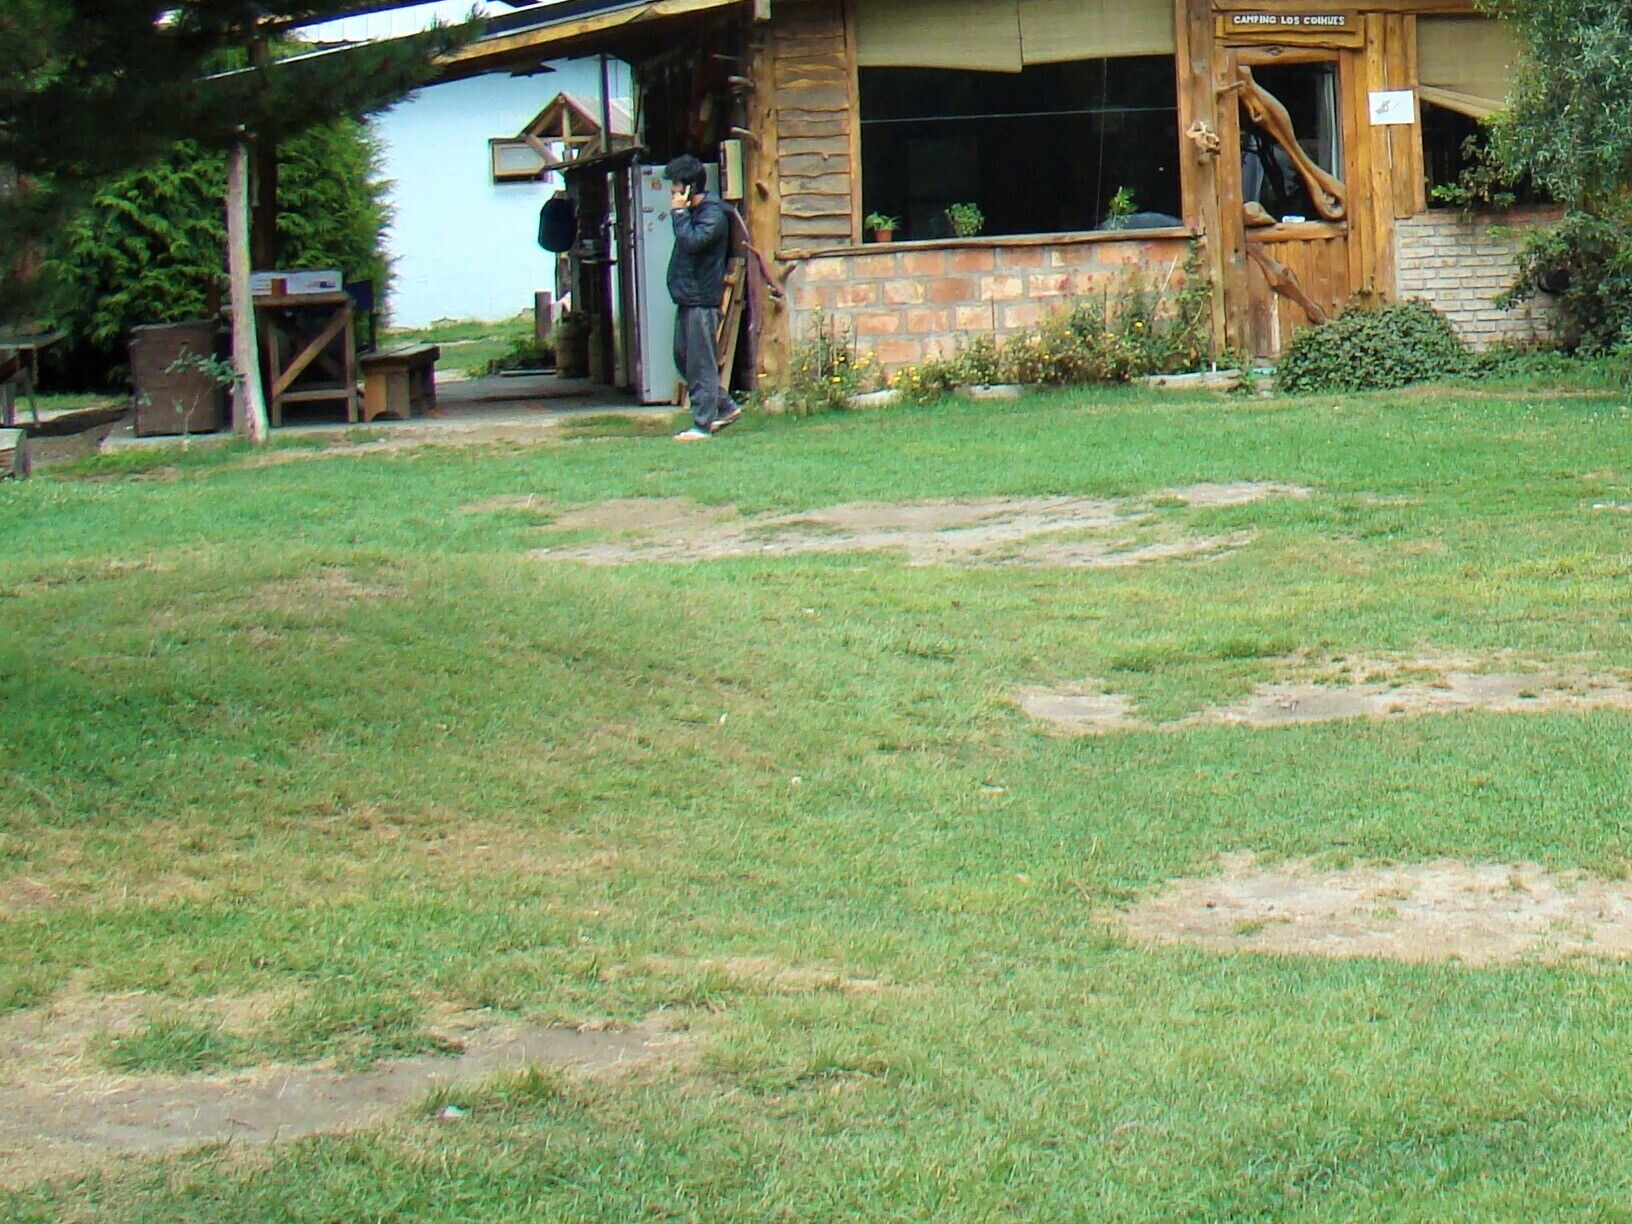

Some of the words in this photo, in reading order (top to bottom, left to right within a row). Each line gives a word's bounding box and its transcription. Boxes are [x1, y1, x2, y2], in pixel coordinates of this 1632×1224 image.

[1233, 15, 1277, 25] CAMPING
[1281, 15, 1300, 25] LOS
[1303, 15, 1345, 26] COIHUES
